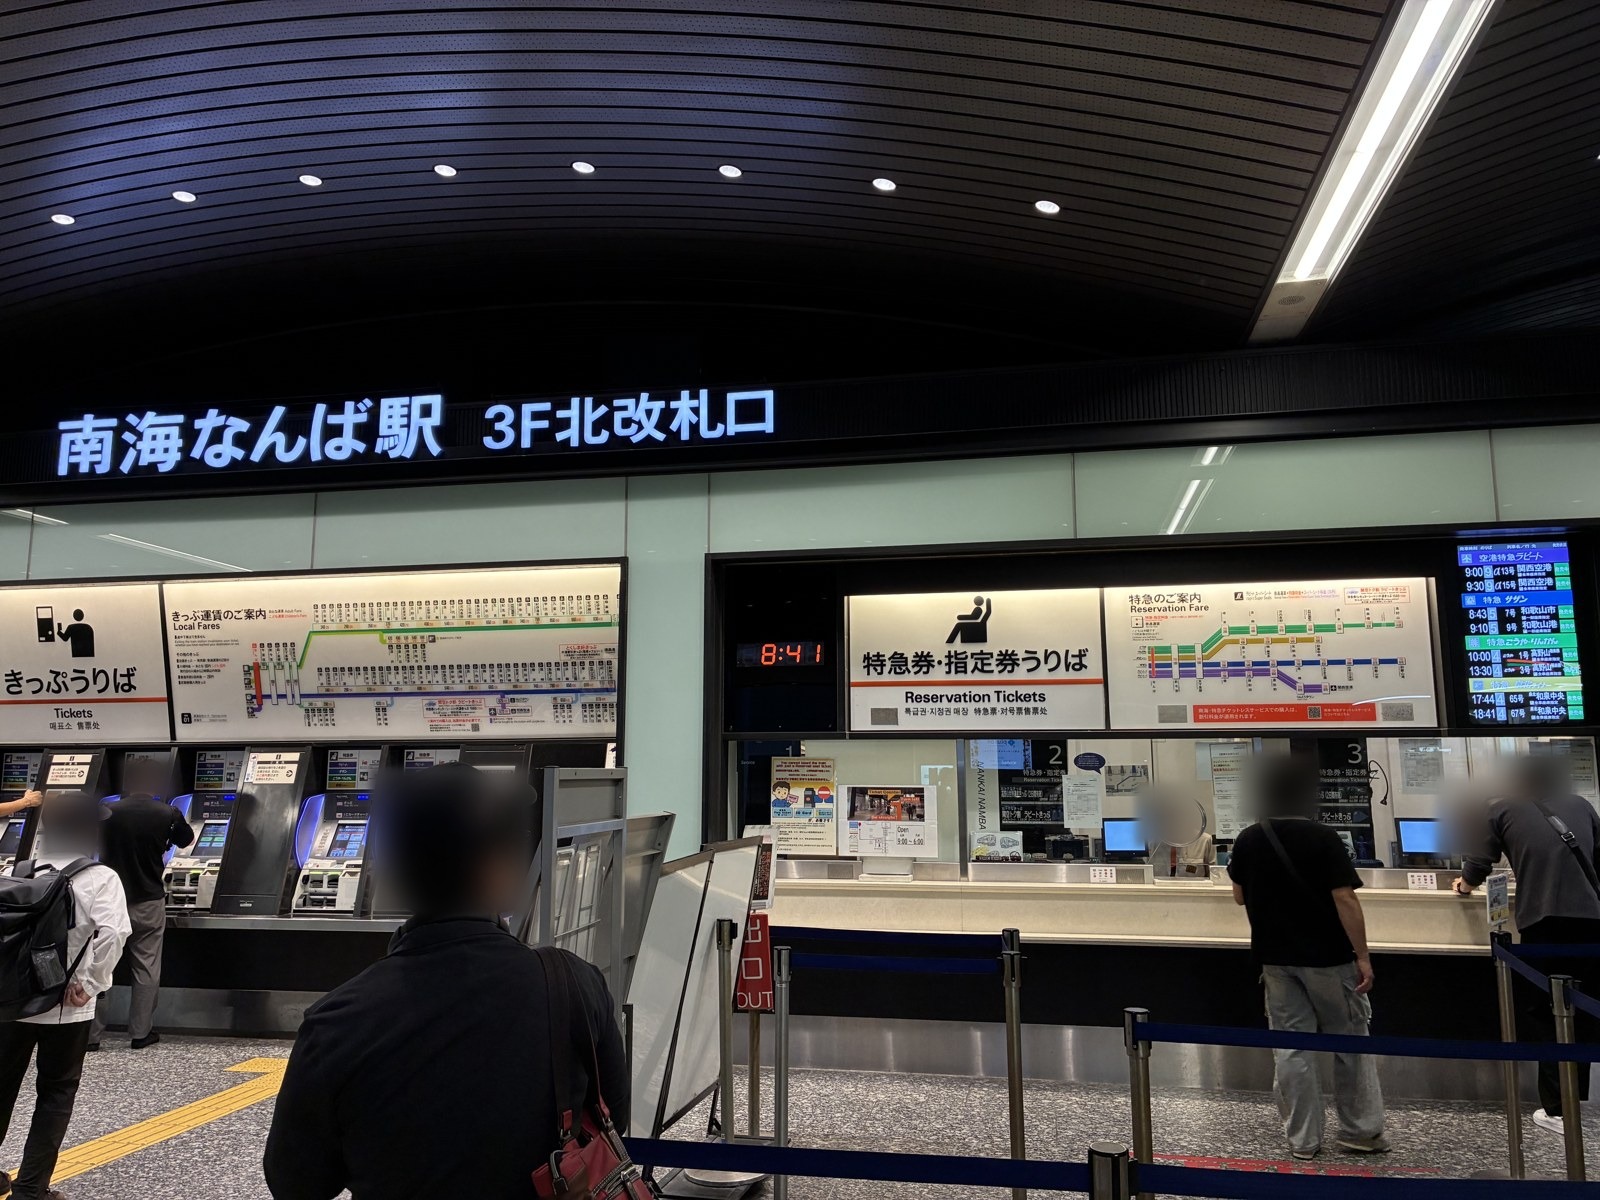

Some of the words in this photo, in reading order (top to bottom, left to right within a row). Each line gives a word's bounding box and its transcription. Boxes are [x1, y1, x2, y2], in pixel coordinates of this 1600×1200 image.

[57, 394, 444, 476] 南海なんば駅
[482, 389, 776, 451] 3F北改札口
[1465, 567, 1483, 578] 9:00
[1517, 564, 1552, 572] 関西空港
[1466, 581, 1484, 591] 9:30
[1518, 578, 1554, 586] 関西空港
[1128, 592, 1202, 605] 特急のご案内
[1504, 595, 1528, 604] サザン
[171, 608, 267, 622] きっぷ運賃のご案内
[1130, 604, 1186, 614] Reservation
[1189, 604, 1210, 612] Fare
[1468, 608, 1487, 619] 8:43
[1504, 608, 1516, 618] 7号
[1520, 606, 1556, 614] 和歌山市
[173, 622, 196, 631] Local
[198, 622, 220, 630] Fares
[1470, 623, 1488, 634] 9:10
[1506, 623, 1518, 632] 9号
[1522, 620, 1558, 629] 和歌山港
[760, 643, 821, 666] 8:41
[1468, 652, 1490, 662] 10:00
[1518, 651, 1529, 660] 1号
[862, 647, 1089, 677] 特急券・指定券うりば
[1469, 666, 1492, 676] 13:30
[1520, 666, 1531, 674] 3号
[4, 666, 137, 695] きっぷうりば
[904, 691, 991, 704] Reservation
[994, 690, 1046, 703] Tickets
[1472, 694, 1495, 704] 17:44
[1509, 694, 1524, 704] 65号
[1536, 692, 1565, 700] 和泉中央
[54, 708, 93, 719] Tickets
[1473, 709, 1496, 719] 18:41
[1510, 708, 1526, 718] 67号
[1537, 706, 1566, 715] 和泉中央
[1048, 744, 1063, 765] 2
[1348, 744, 1362, 764] 3
[977, 761, 986, 796] NANKAI
[978, 797, 987, 830] NAMBA
[914, 838, 924, 846] 6:00
[737, 992, 773, 1008] OUT
